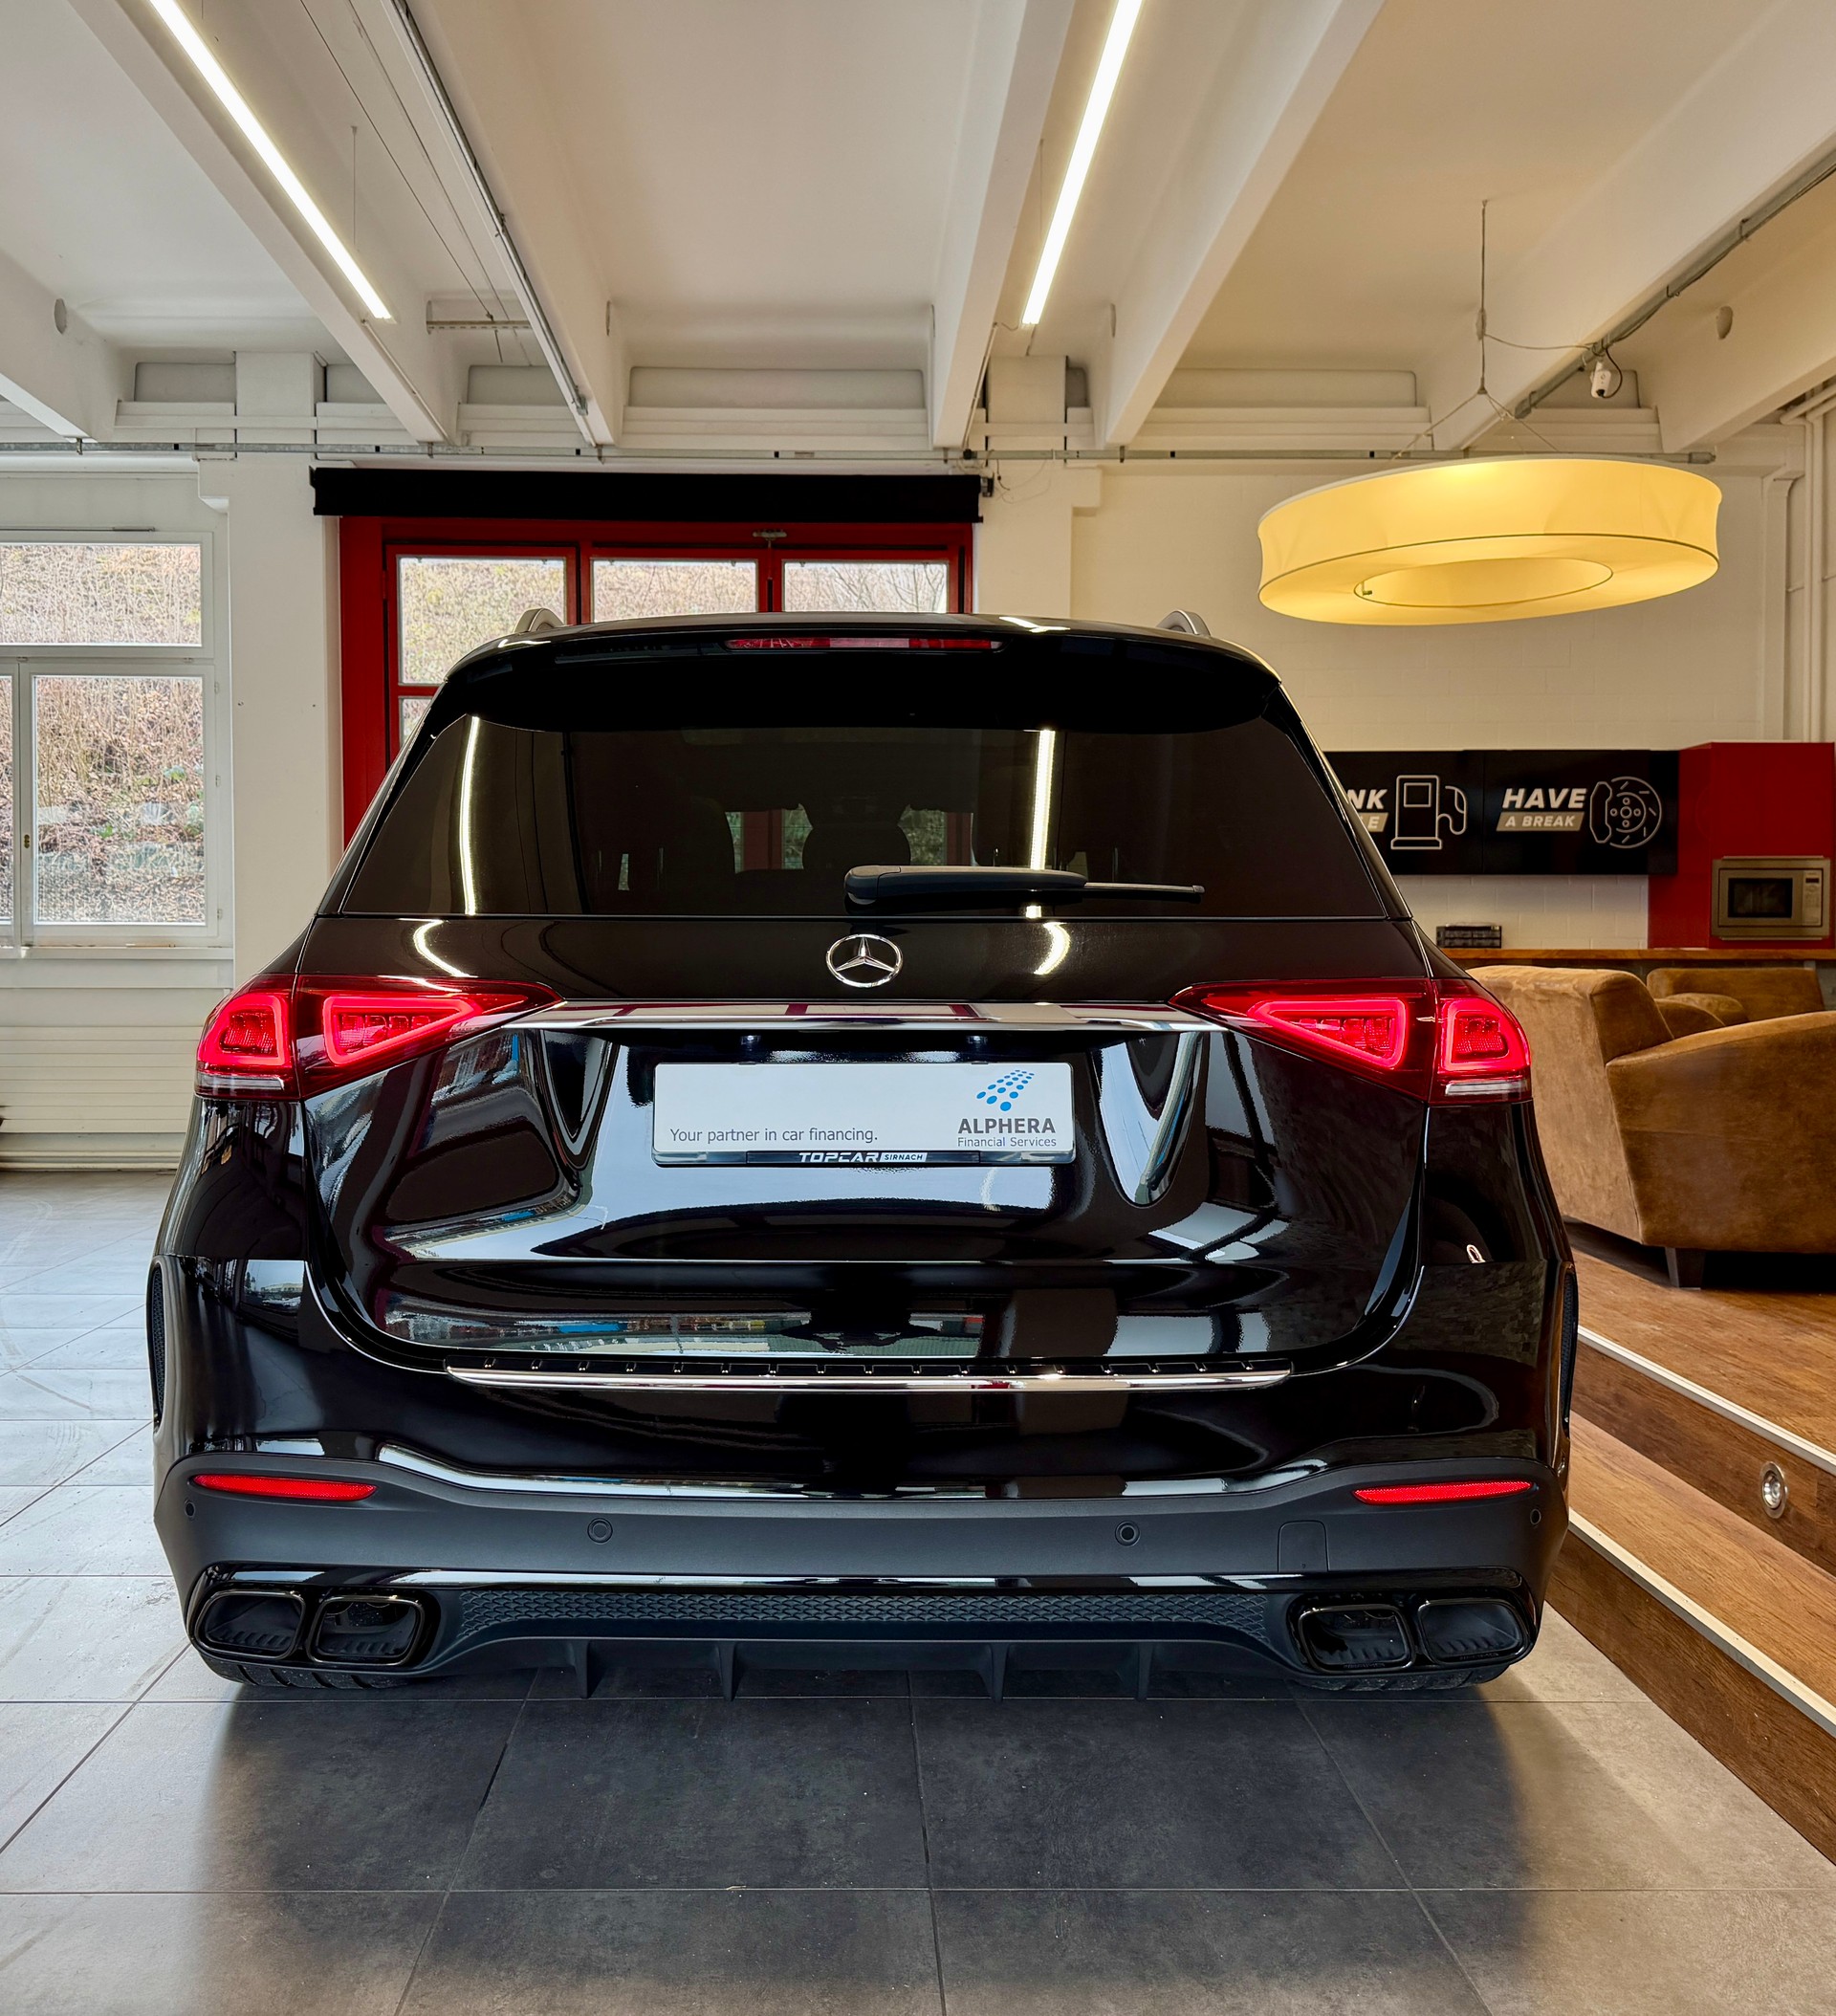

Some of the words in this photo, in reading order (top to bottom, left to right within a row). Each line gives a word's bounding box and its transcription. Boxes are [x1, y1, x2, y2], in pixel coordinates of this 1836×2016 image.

[1502, 788, 1587, 808] HAVE
[1504, 816, 1516, 826] A
[1521, 815, 1576, 826] BREAK
[957, 1117, 1057, 1134] ALPHERA
[670, 1128, 703, 1142] Your
[708, 1128, 760, 1145] partner
[764, 1128, 777, 1141] in
[782, 1129, 805, 1141] car
[809, 1127, 878, 1144] financing.
[957, 1136, 1006, 1148] Financial
[1010, 1136, 1057, 1148] Services
[798, 1151, 880, 1163] TOPCAR
